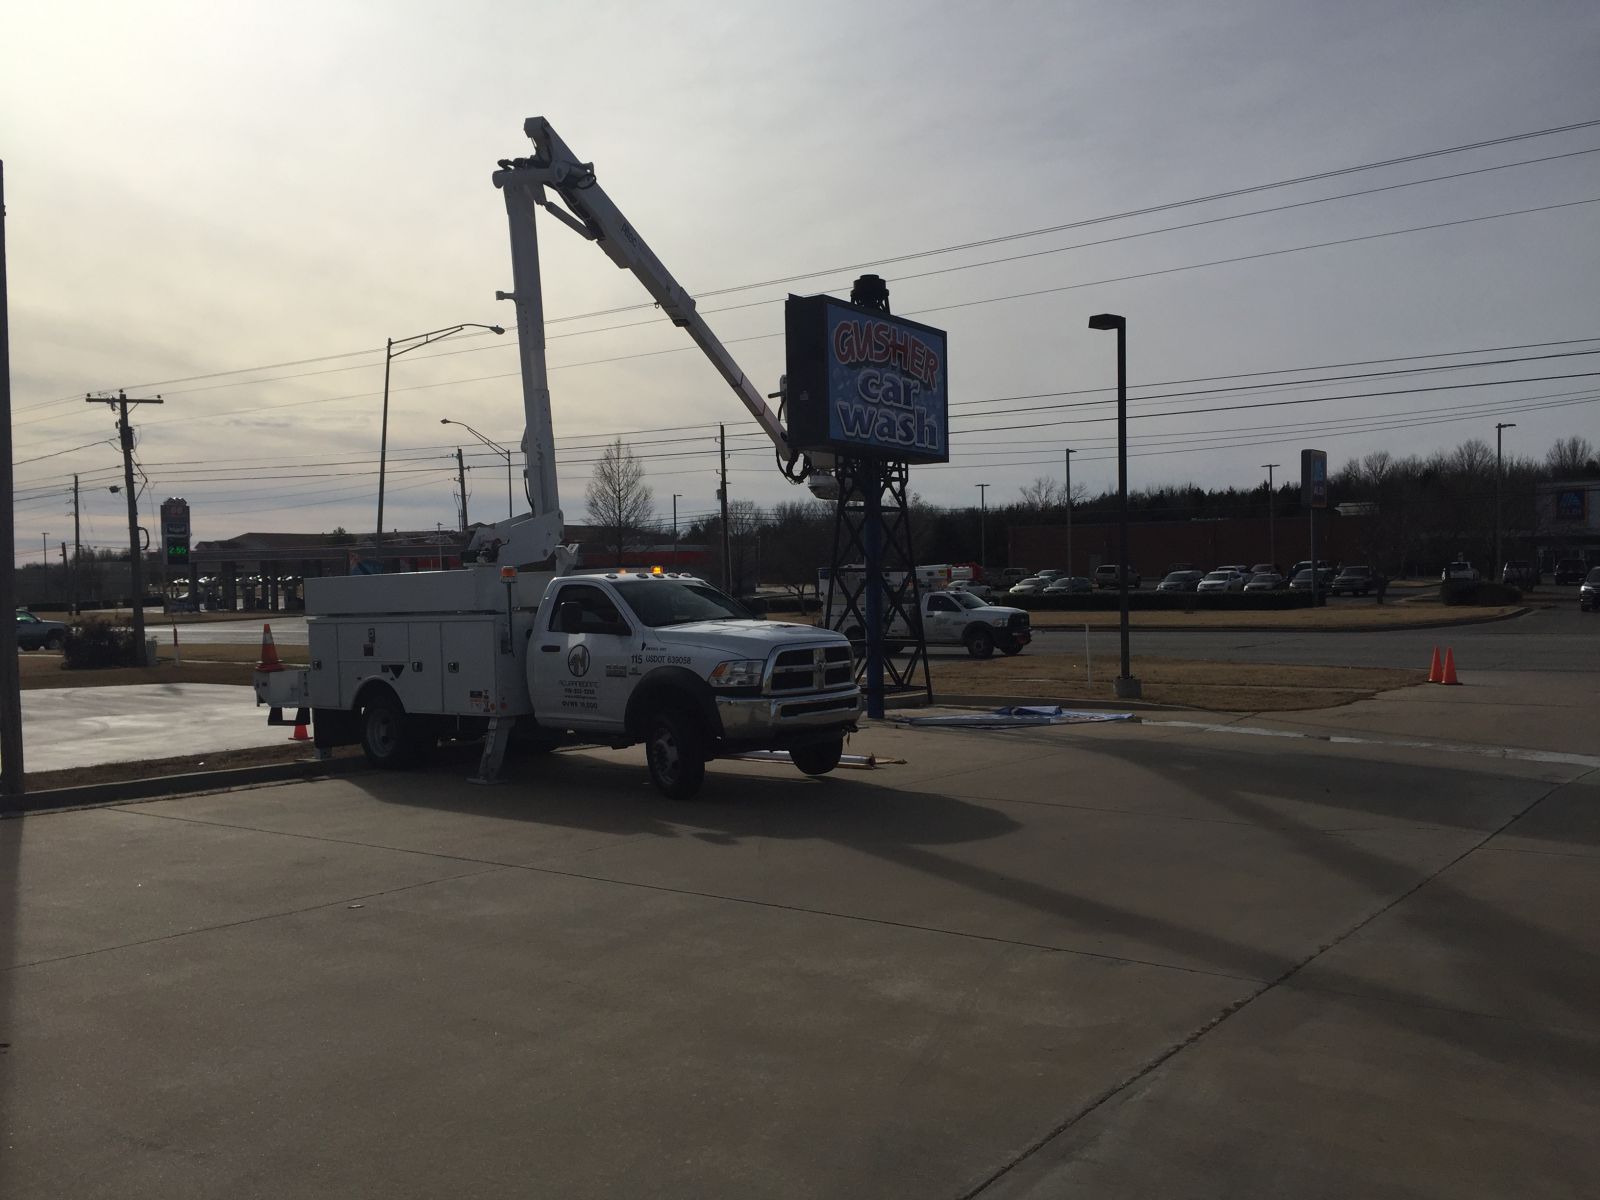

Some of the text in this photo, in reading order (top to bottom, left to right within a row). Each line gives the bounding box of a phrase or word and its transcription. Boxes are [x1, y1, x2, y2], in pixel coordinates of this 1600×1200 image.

[834, 319, 939, 391] GUSHER
[857, 368, 921, 410] car
[631, 653, 643, 664] 115
[645, 654, 666, 664] USDOT
